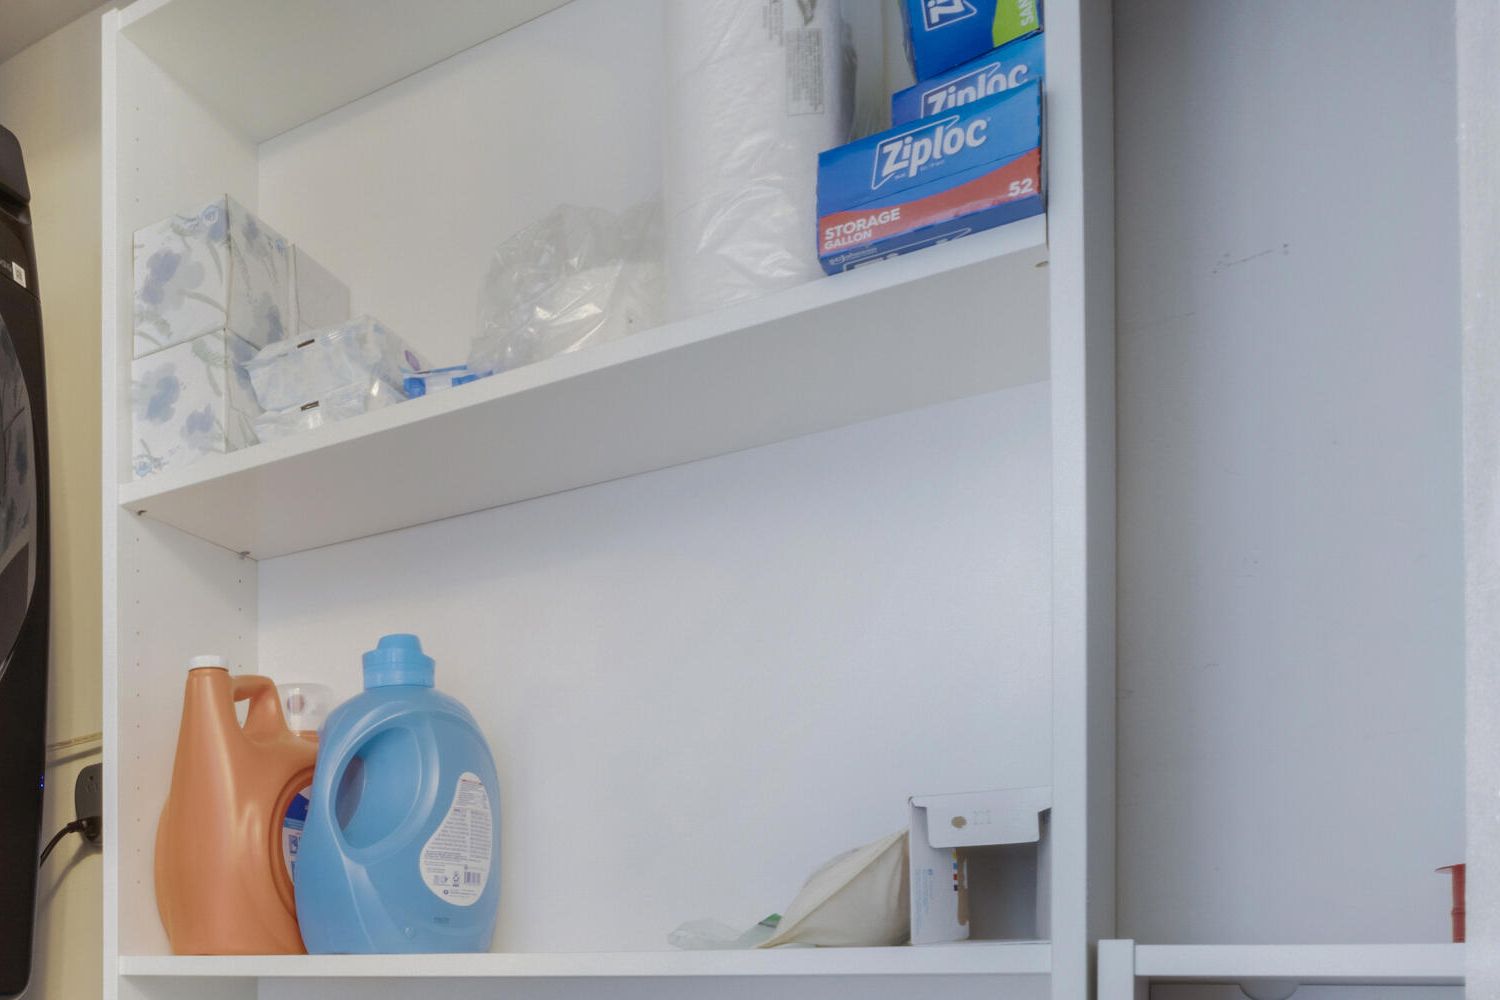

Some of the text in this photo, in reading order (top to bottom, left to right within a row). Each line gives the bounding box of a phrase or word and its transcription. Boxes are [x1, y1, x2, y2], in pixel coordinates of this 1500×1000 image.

[881, 119, 988, 178] Ziploc
[1008, 178, 1033, 197] 52
[824, 207, 901, 241] STORAGE
[824, 230, 872, 250] GALLON
